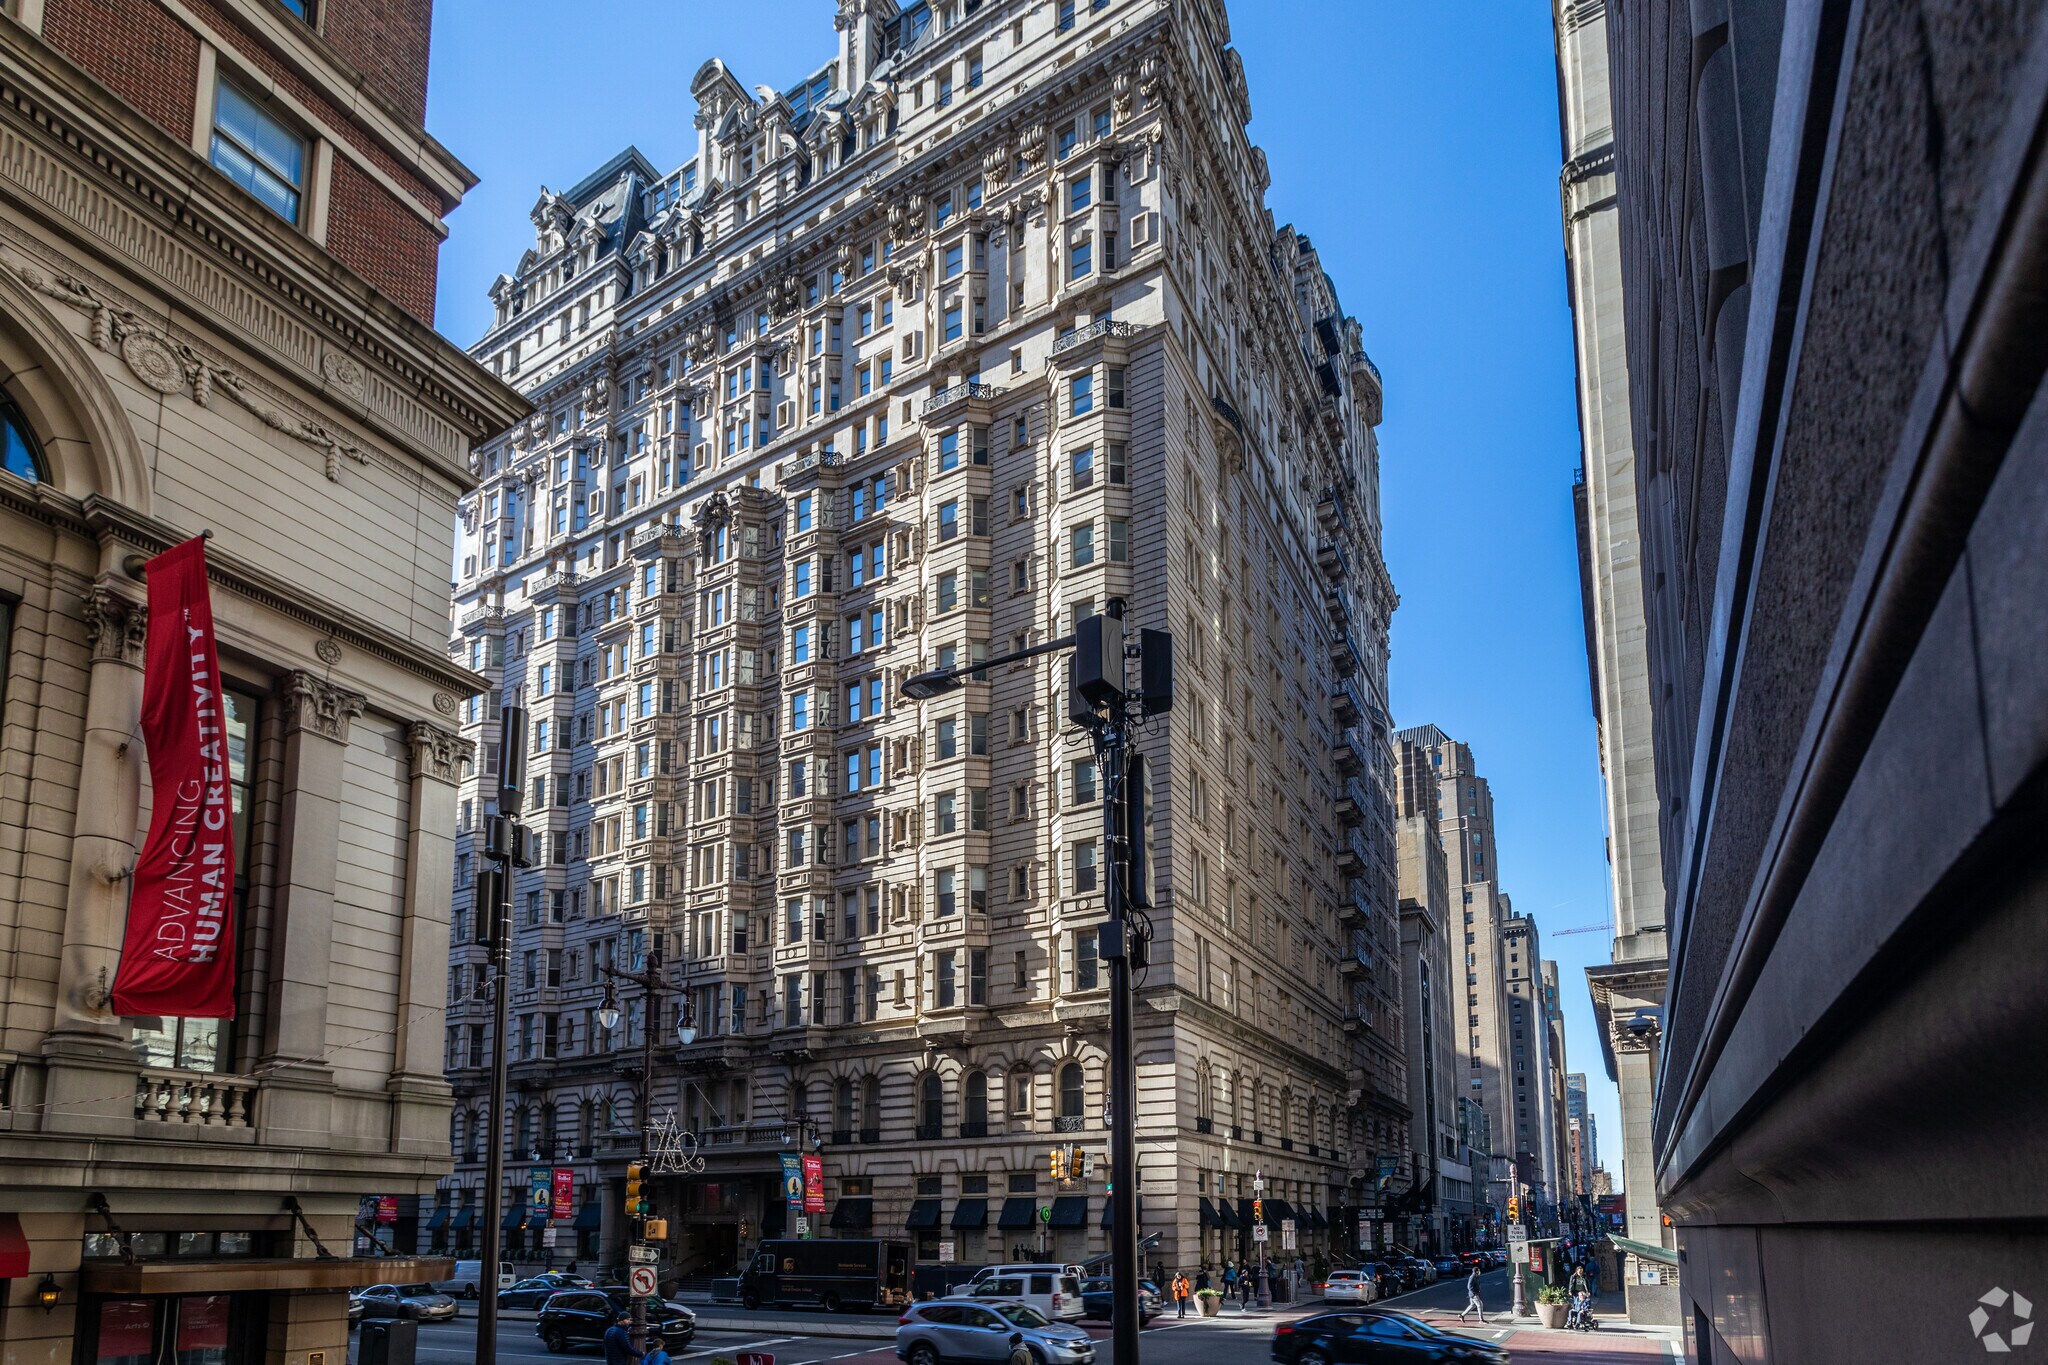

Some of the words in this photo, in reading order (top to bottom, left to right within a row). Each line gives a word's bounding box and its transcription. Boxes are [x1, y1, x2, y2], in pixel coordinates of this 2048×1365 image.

[190, 626, 226, 831] CREATIVITY
[154, 778, 201, 961] ADVANCING
[188, 843, 226, 963] HUMAN
